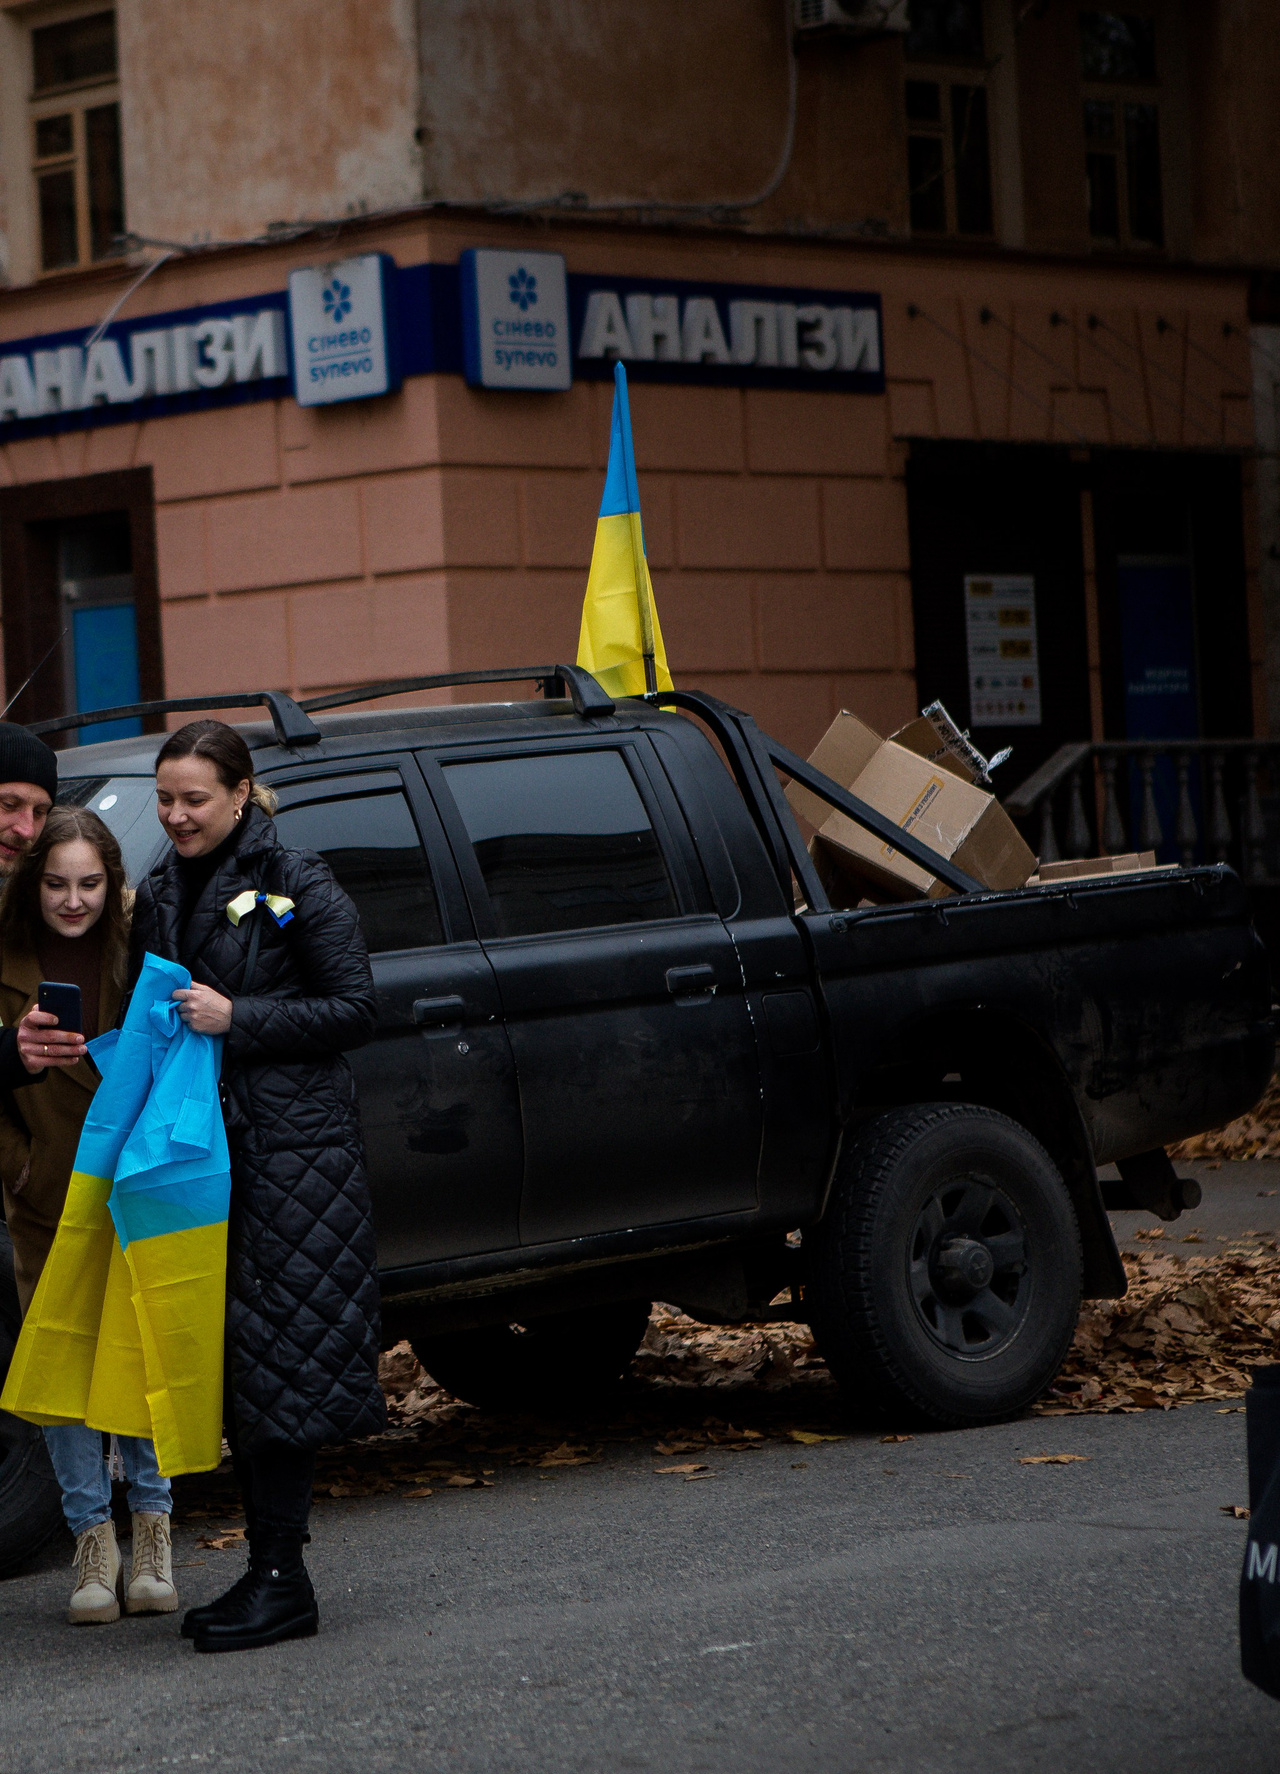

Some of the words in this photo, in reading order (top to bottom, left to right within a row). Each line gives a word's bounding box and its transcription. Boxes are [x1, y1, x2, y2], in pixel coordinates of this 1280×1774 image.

[578, 289, 881, 374] АНАЛІЗИ
[310, 357, 373, 387] synevo
[494, 349, 558, 371] synevo
